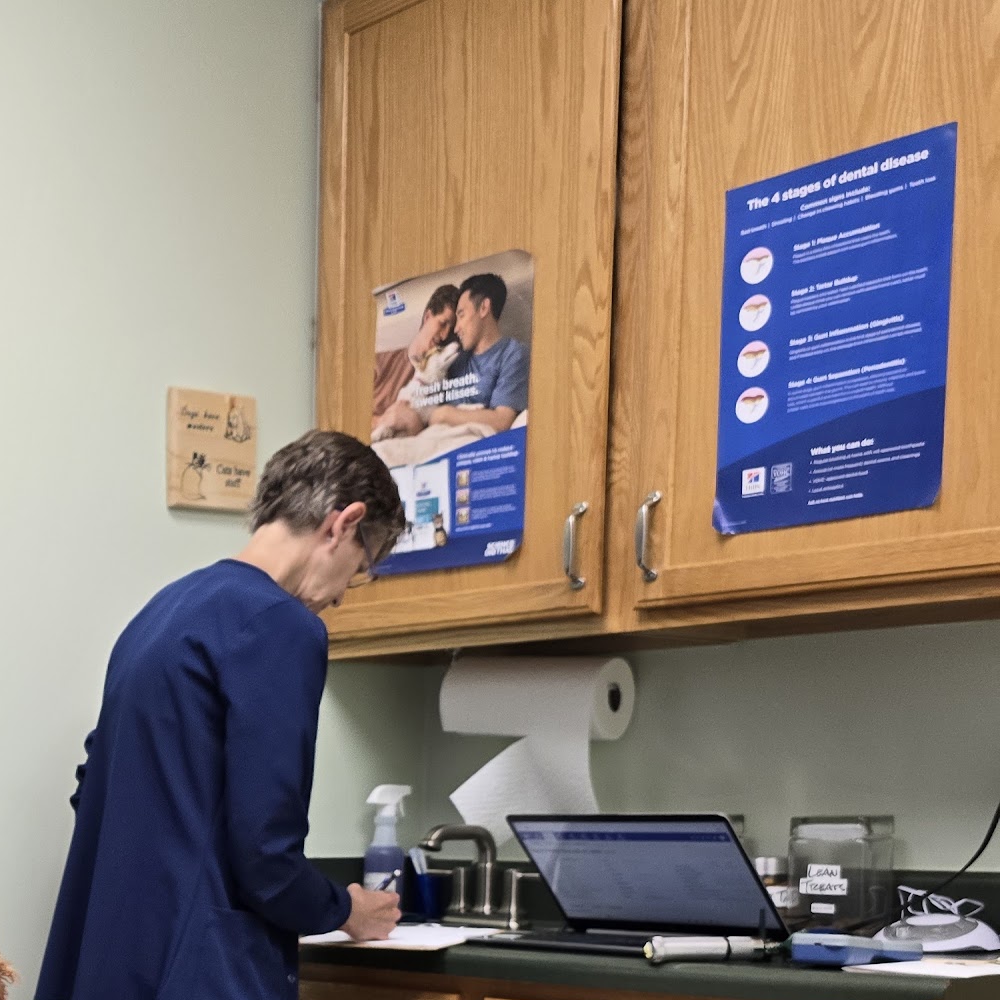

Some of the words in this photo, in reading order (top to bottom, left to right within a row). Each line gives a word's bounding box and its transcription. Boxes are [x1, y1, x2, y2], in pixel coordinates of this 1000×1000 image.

[746, 197, 769, 211] The
[771, 191, 780, 204] 4
[782, 181, 821, 202] stages
[823, 173, 837, 189] of
[838, 161, 879, 184] dental
[880, 149, 930, 171] disease
[442, 372, 479, 391] breath.
[445, 386, 479, 402] kisses.
[810, 445, 831, 456] What
[831, 443, 846, 454] you
[846, 441, 861, 450] can
[808, 866, 838, 878] LEAN
[800, 880, 846, 892] TREATS
